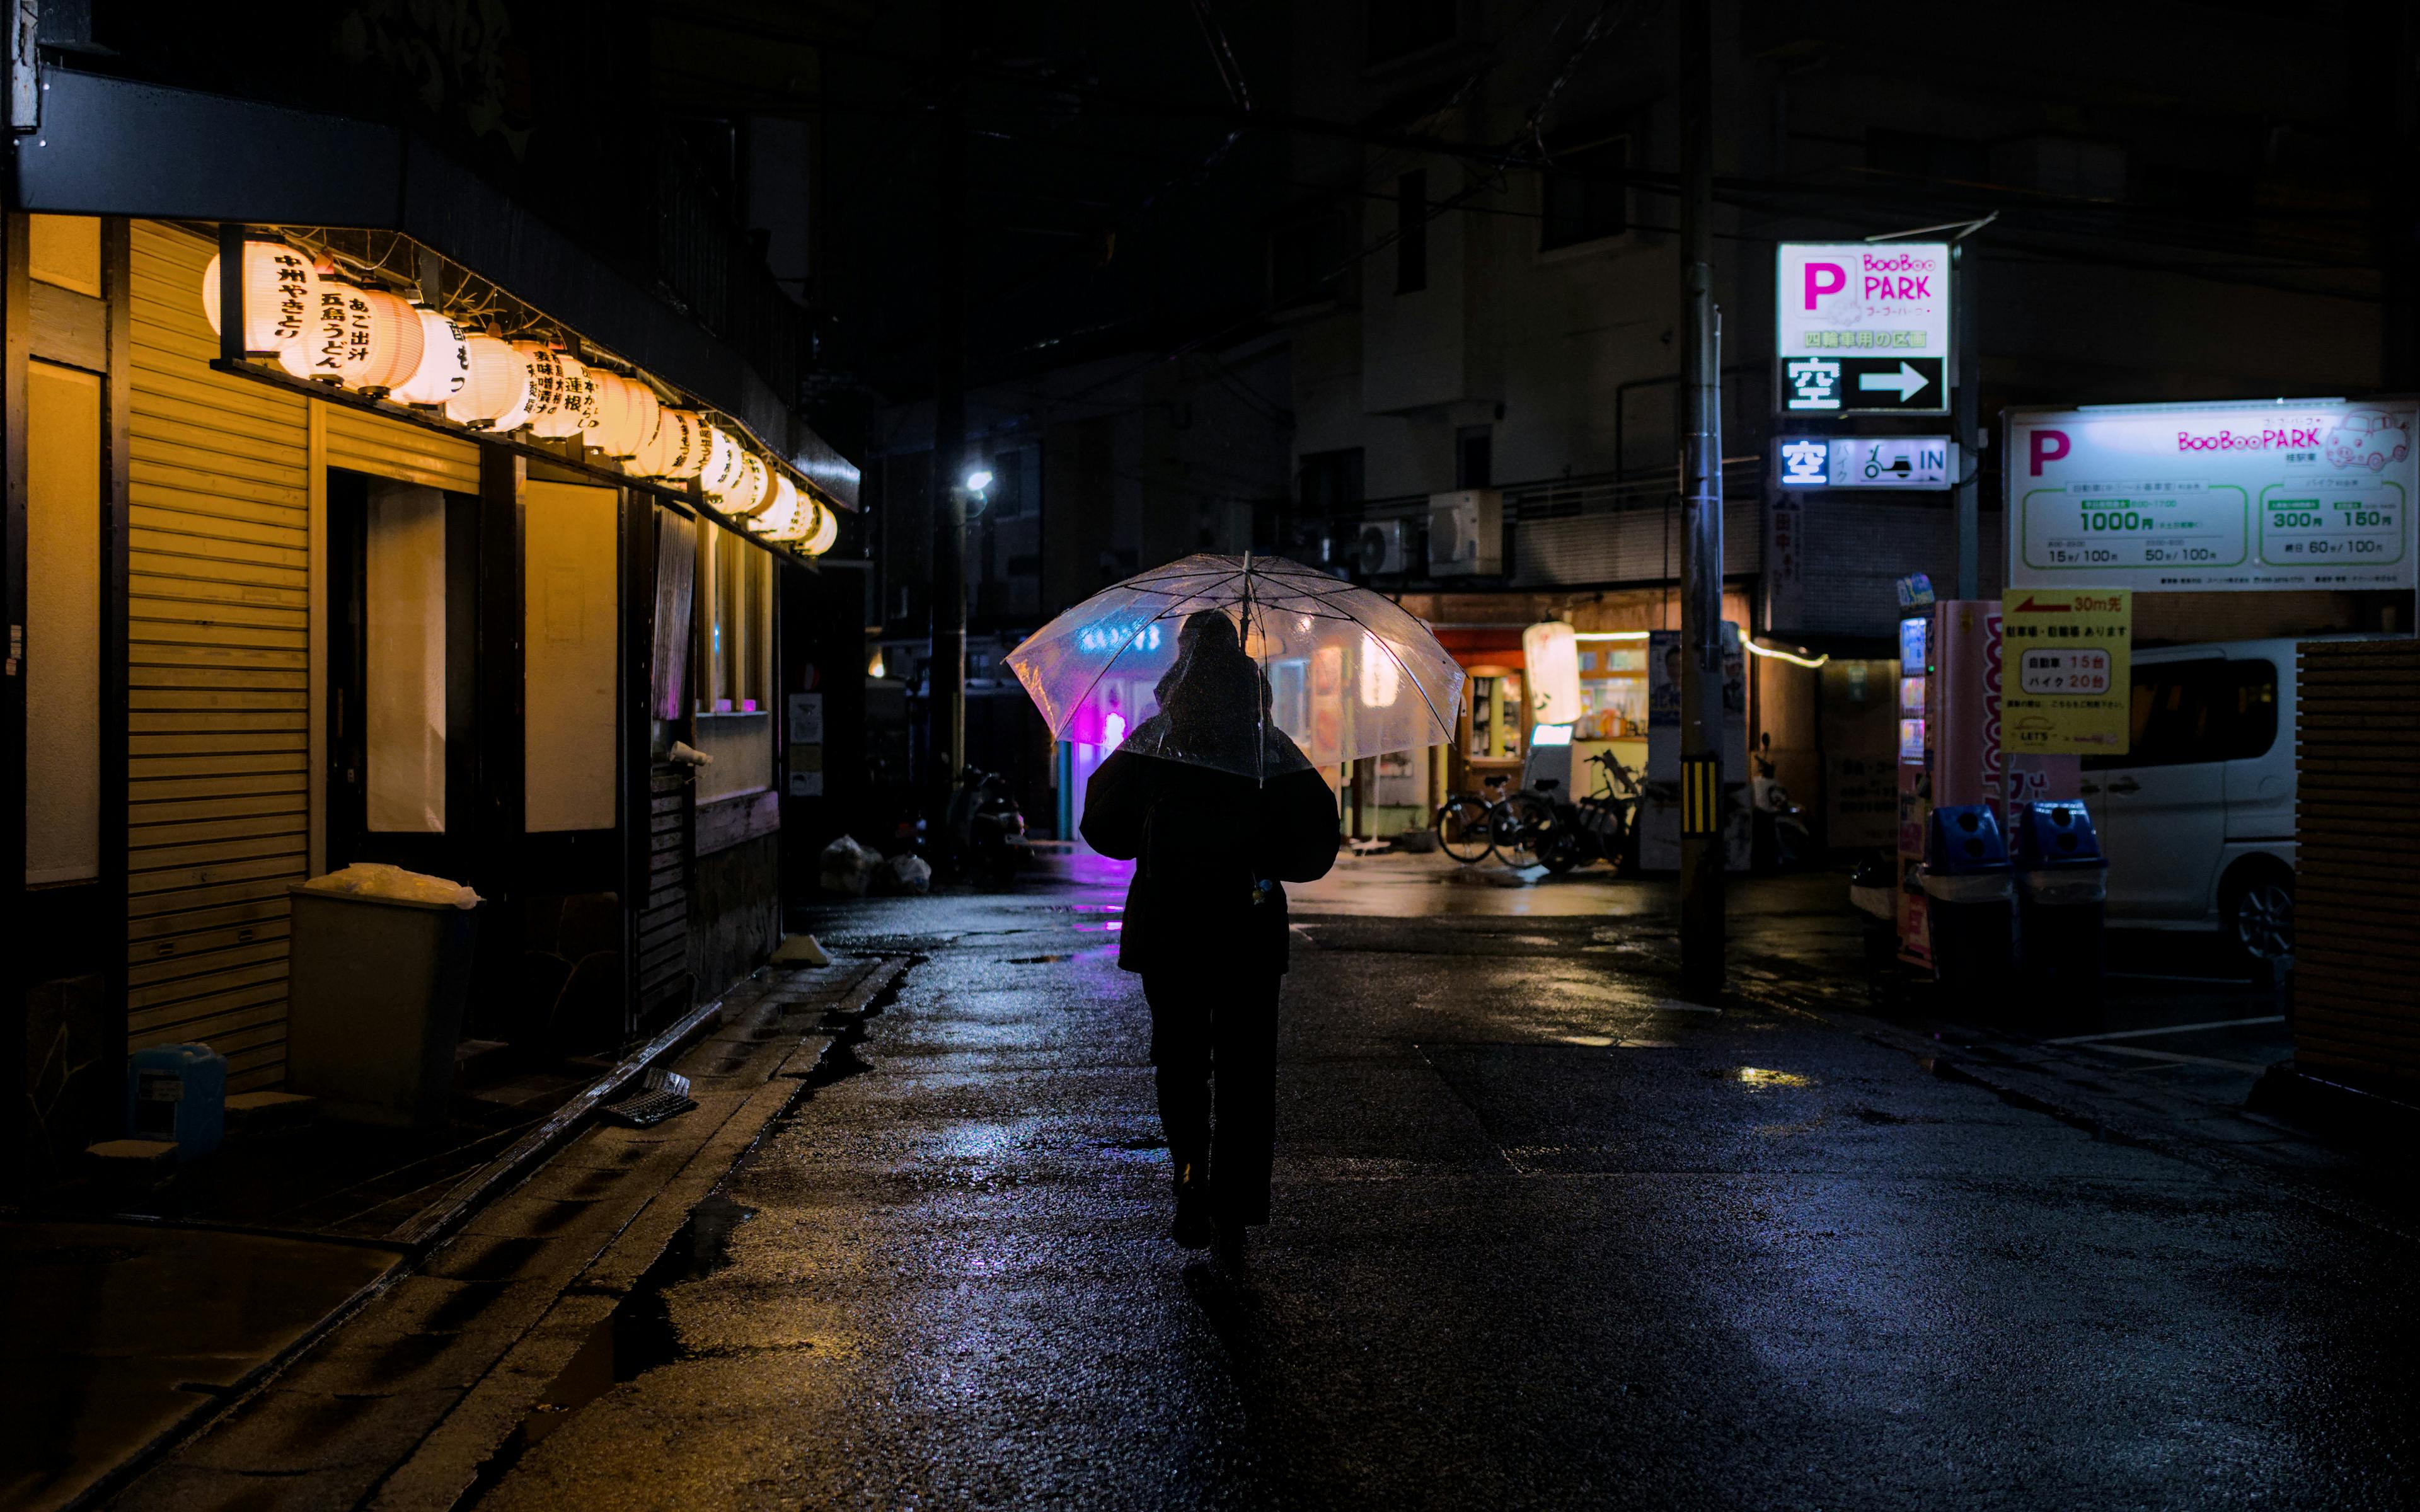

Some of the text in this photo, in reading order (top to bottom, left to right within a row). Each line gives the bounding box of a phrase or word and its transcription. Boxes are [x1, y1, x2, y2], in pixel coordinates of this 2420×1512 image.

[1805, 263, 1846, 310] P
[1865, 276, 1931, 301] PARK
[316, 292, 348, 369] 五島うどん
[349, 299, 372, 361] あご出汁
[564, 377, 583, 411] 蓮根
[1789, 358, 1840, 410] 空
[1782, 440, 1828, 484] 空
[1921, 450, 1944, 469] IN
[2030, 430, 2071, 476] P
[2081, 512, 2153, 531] 1000円
[2274, 513, 2322, 527] 300円
[2345, 512, 2392, 526] 150円
[2074, 596, 2121, 612] 30m先
[2029, 657, 2104, 668] 自動車 15台
[2029, 675, 2104, 689] バイク 20台
